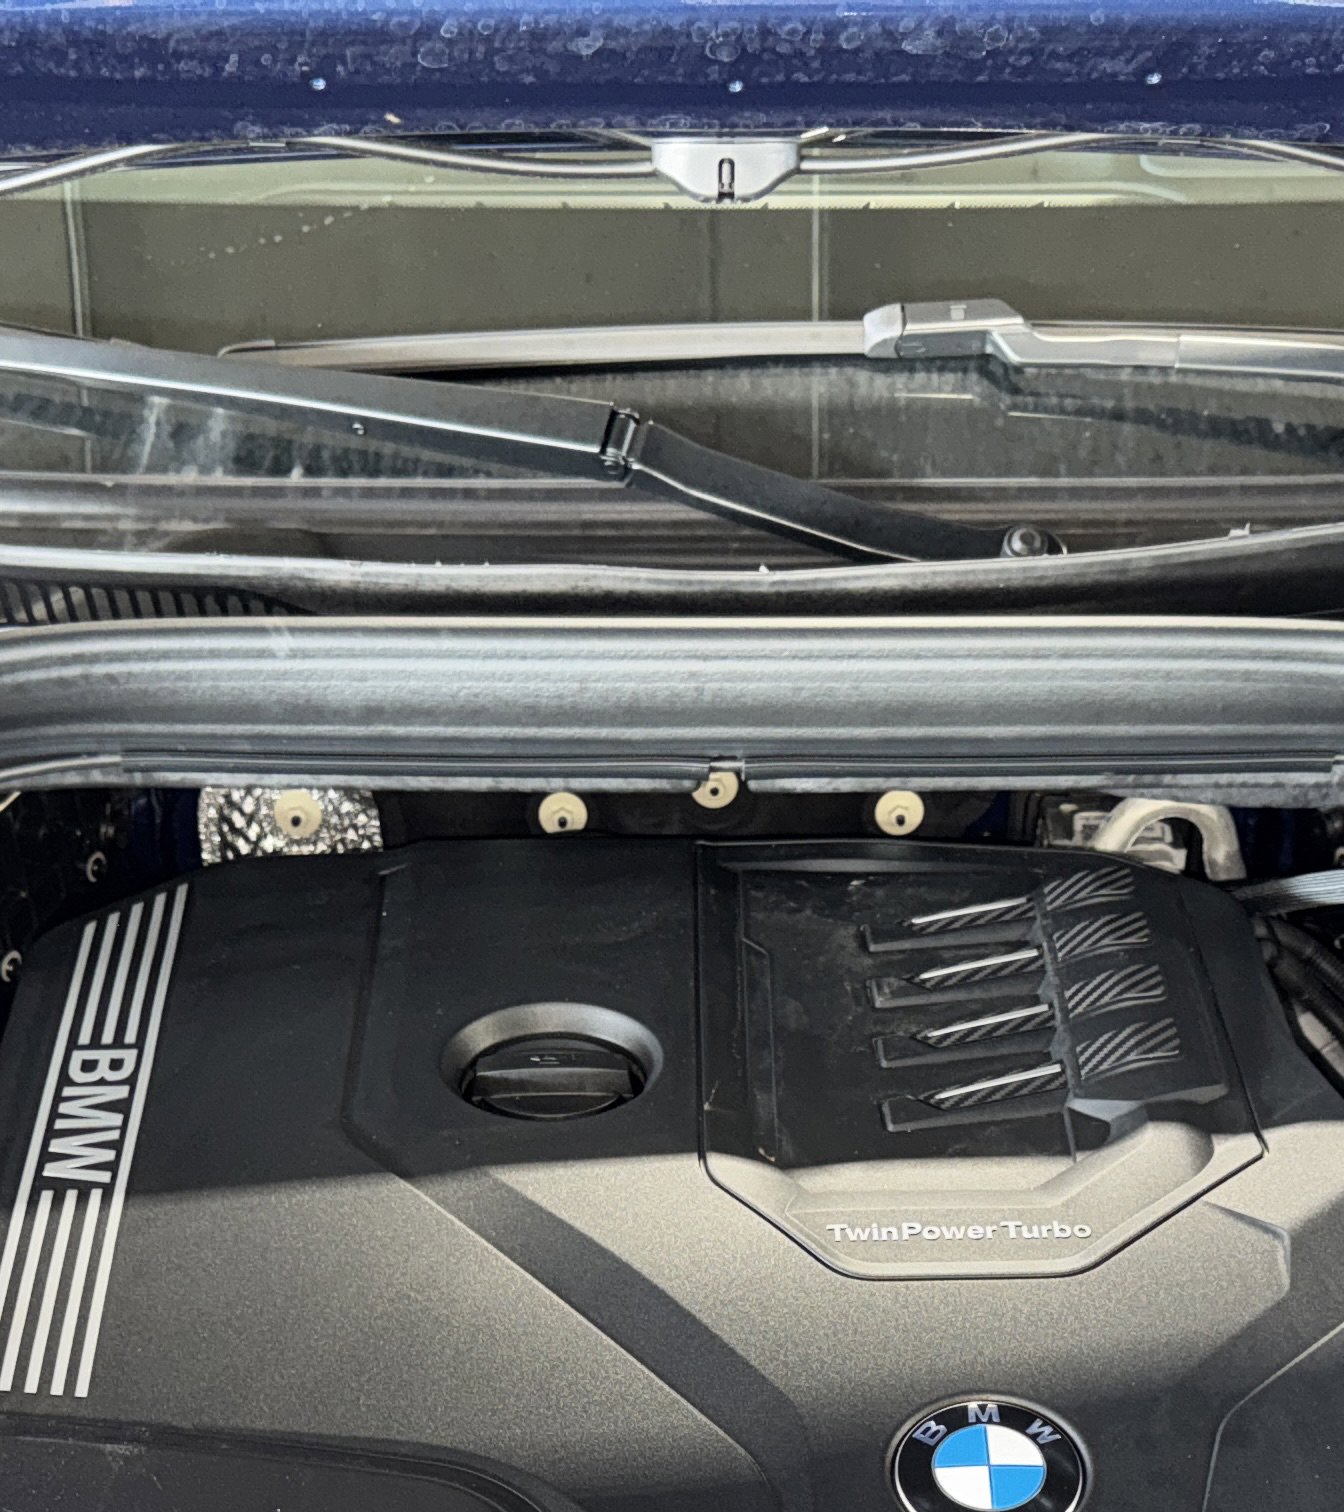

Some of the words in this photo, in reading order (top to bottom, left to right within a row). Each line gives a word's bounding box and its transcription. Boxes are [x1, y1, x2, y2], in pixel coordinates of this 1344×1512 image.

[42, 1048, 138, 1184] BMW
[1000, 1220, 1092, 1240] Turbo
[912, 1403, 1061, 1446] BMW
